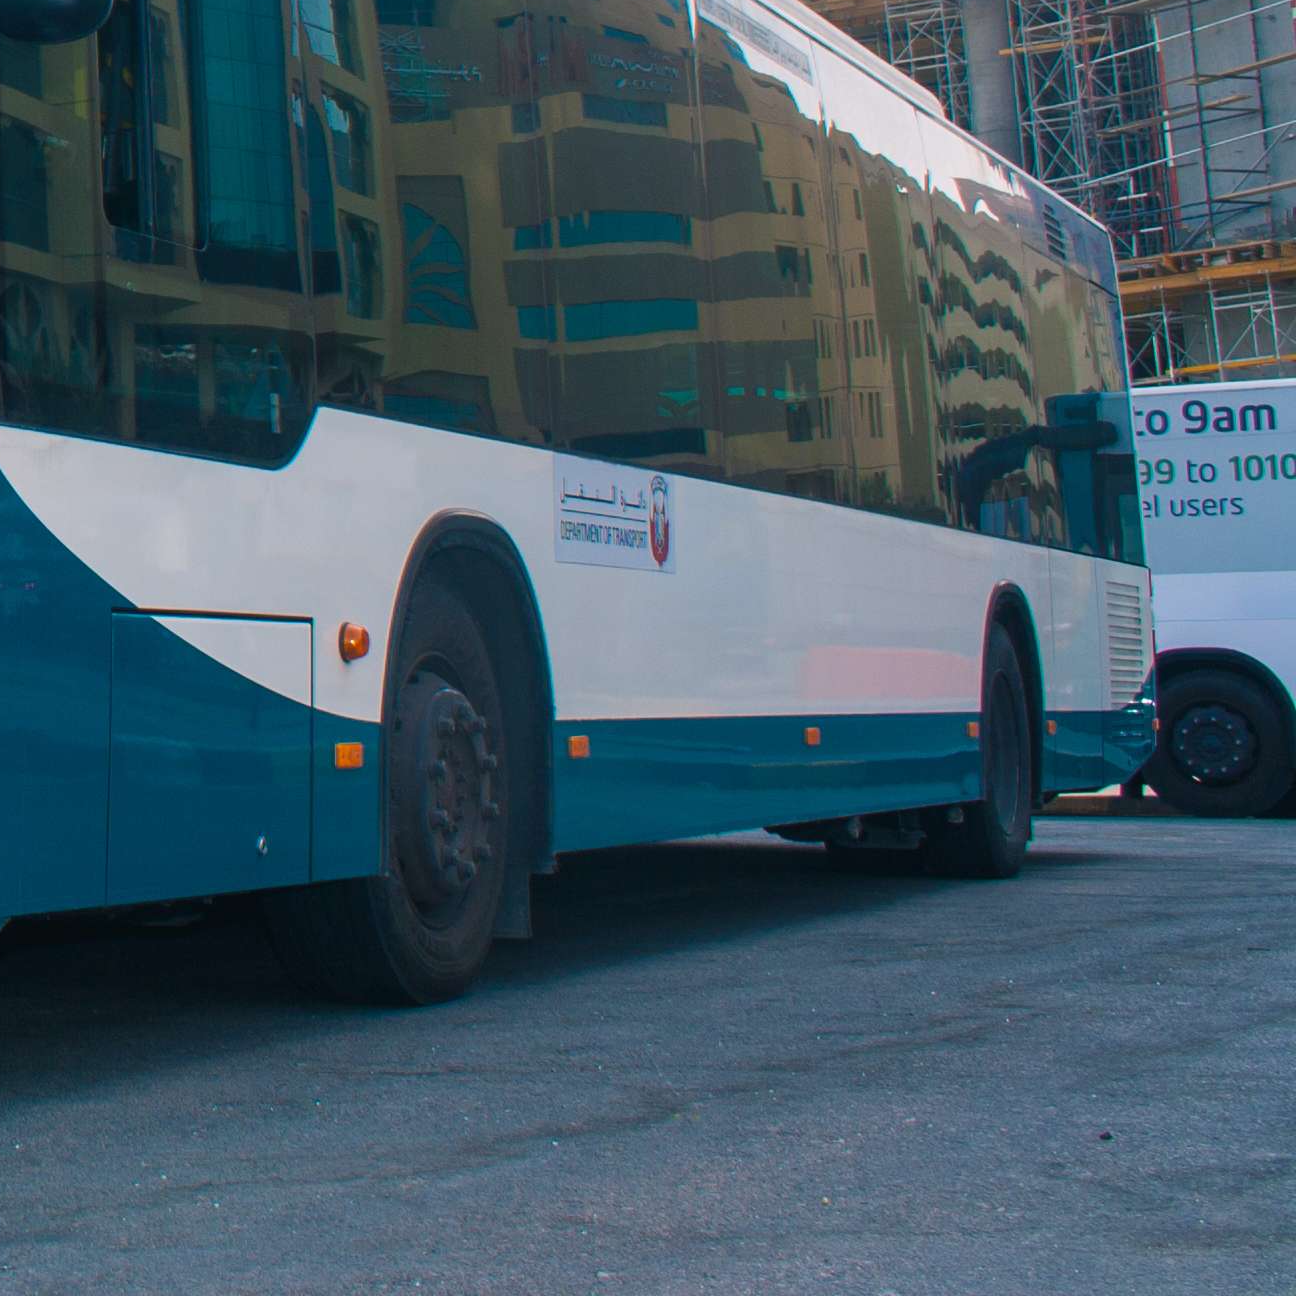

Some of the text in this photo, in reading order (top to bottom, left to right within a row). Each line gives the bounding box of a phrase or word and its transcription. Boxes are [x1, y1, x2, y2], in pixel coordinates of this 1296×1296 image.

[1182, 400, 1276, 434] 9am
[1186, 460, 1216, 483] to
[1170, 497, 1244, 517] users
[560, 520, 648, 549] DEPARTMENT OF TRANSPORT
